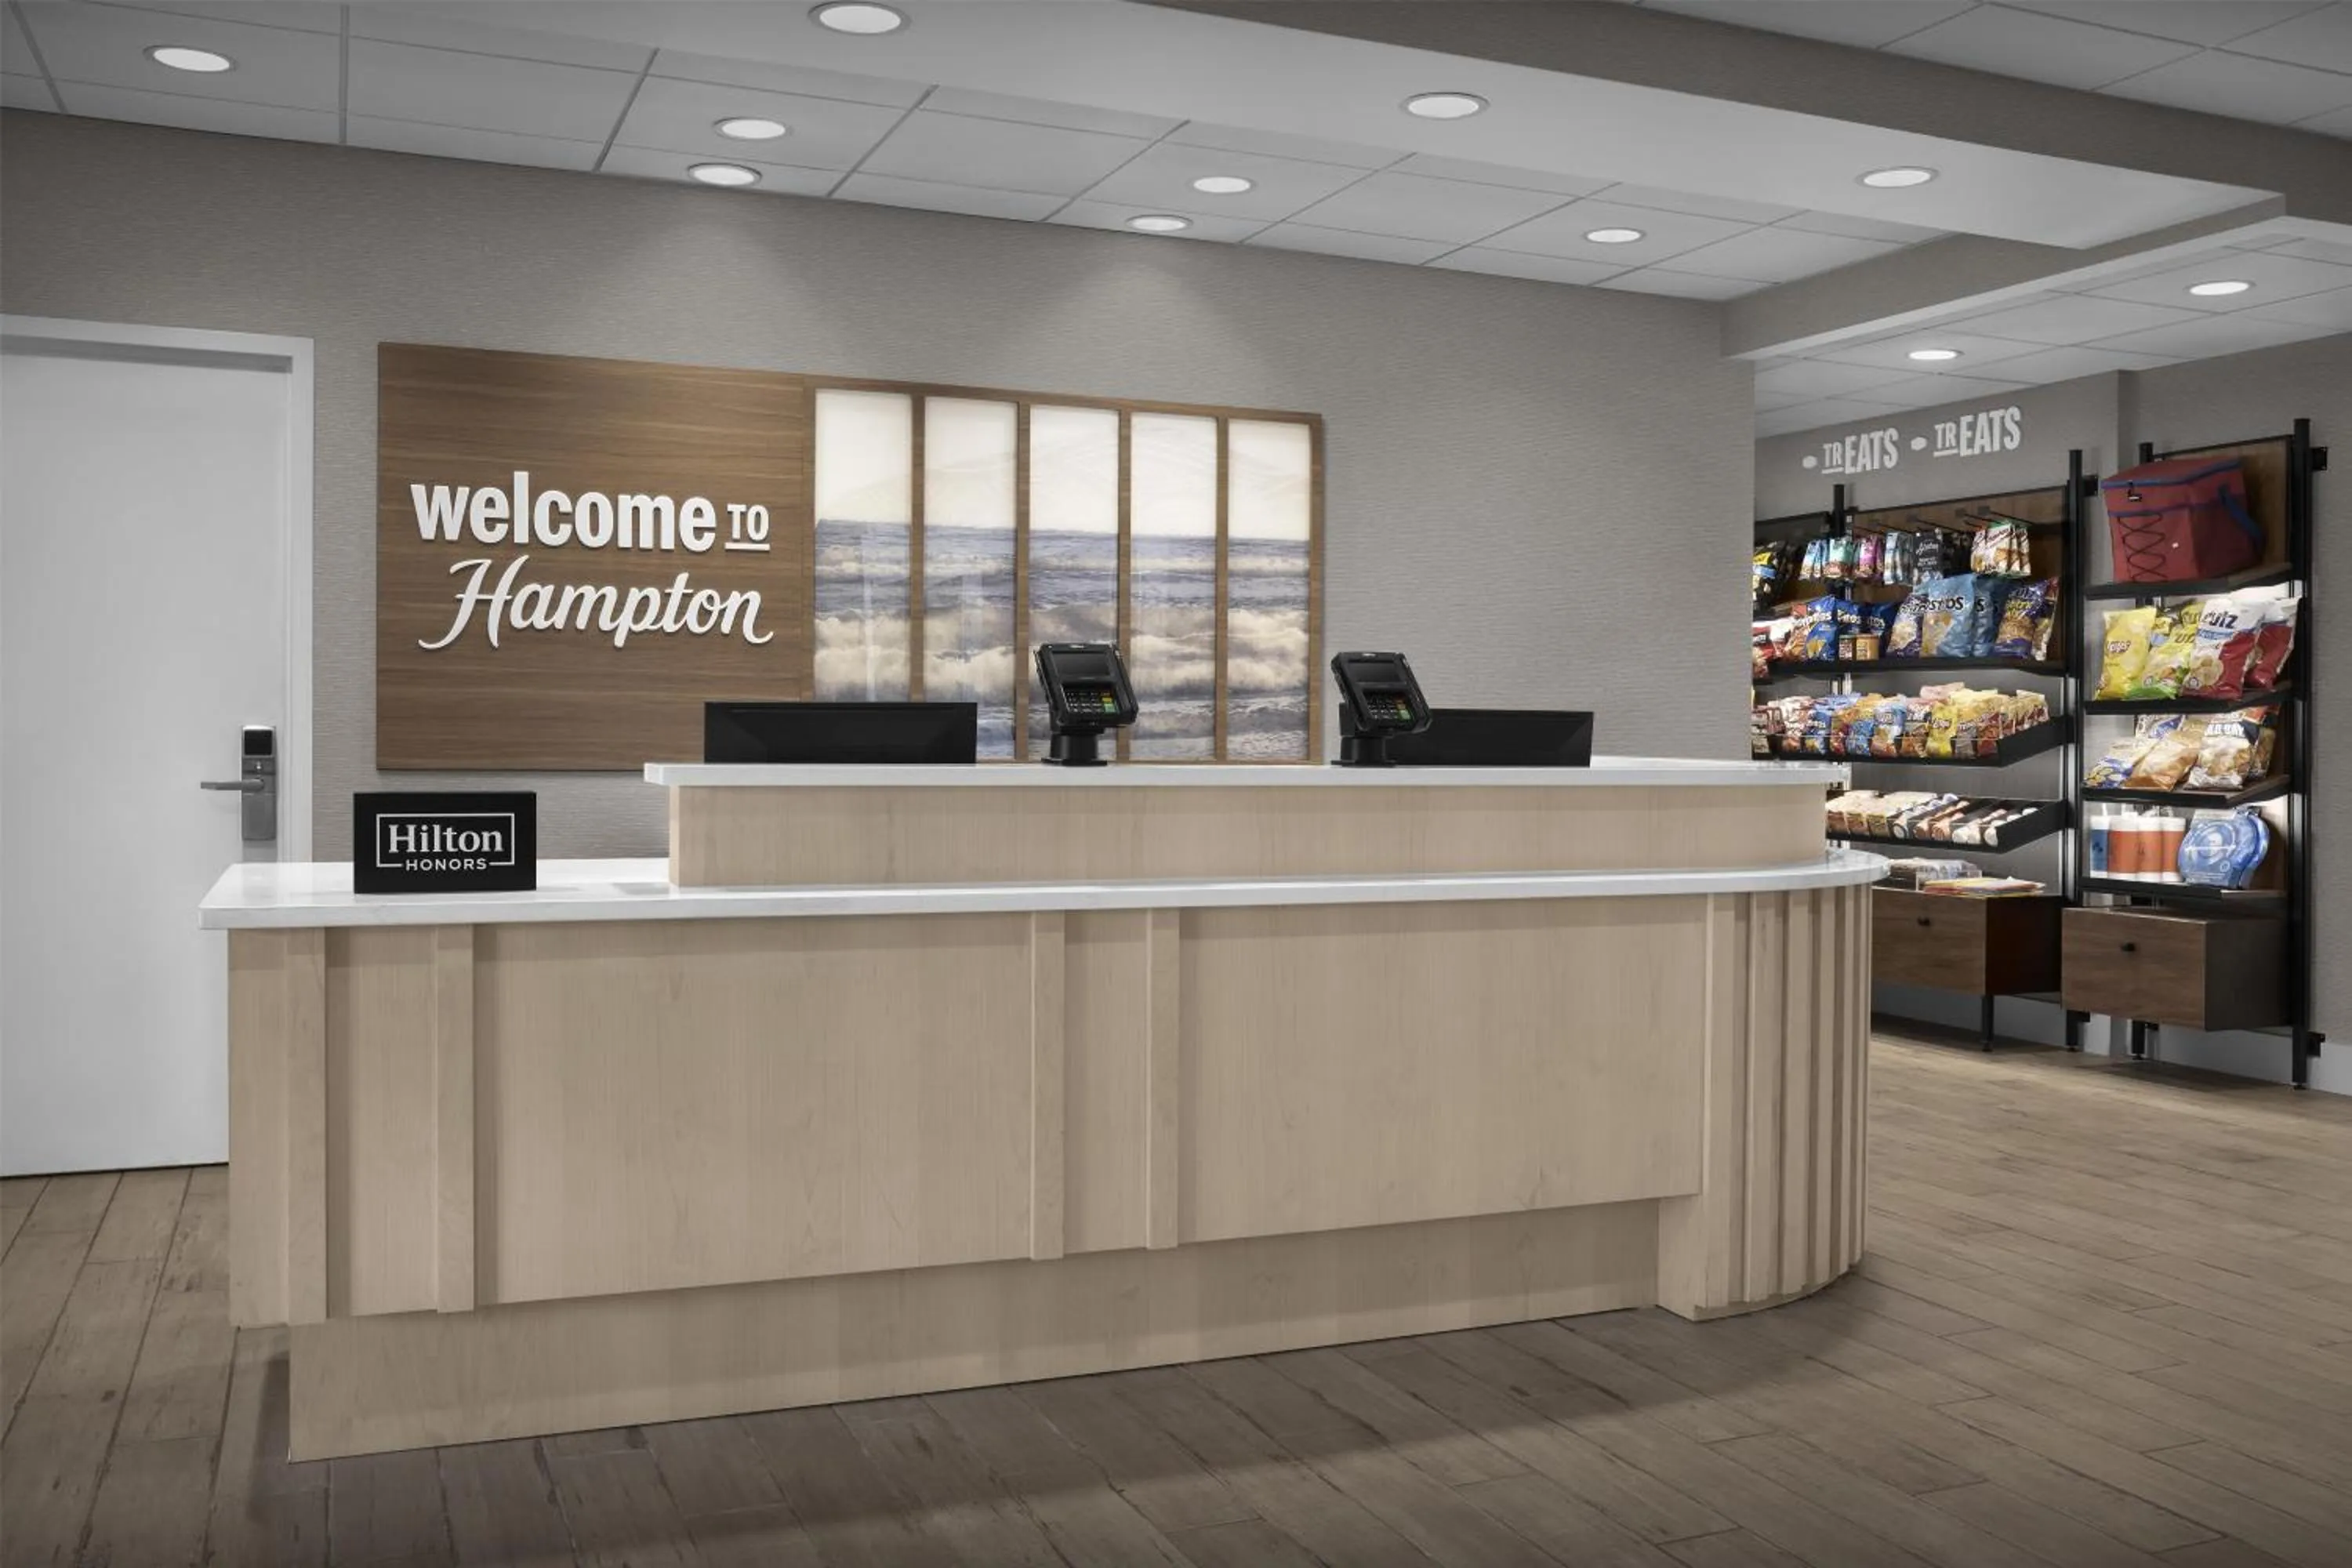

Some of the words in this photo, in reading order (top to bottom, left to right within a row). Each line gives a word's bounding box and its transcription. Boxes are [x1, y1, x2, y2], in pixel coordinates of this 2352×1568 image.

[1821, 427, 1899, 474] TREATS
[1933, 406, 2021, 457] TREATS
[410, 470, 717, 552] welcome
[726, 504, 770, 550] TO
[417, 555, 775, 650] Hampton
[388, 824, 504, 853] Hilton
[405, 858, 488, 871] HONORS
